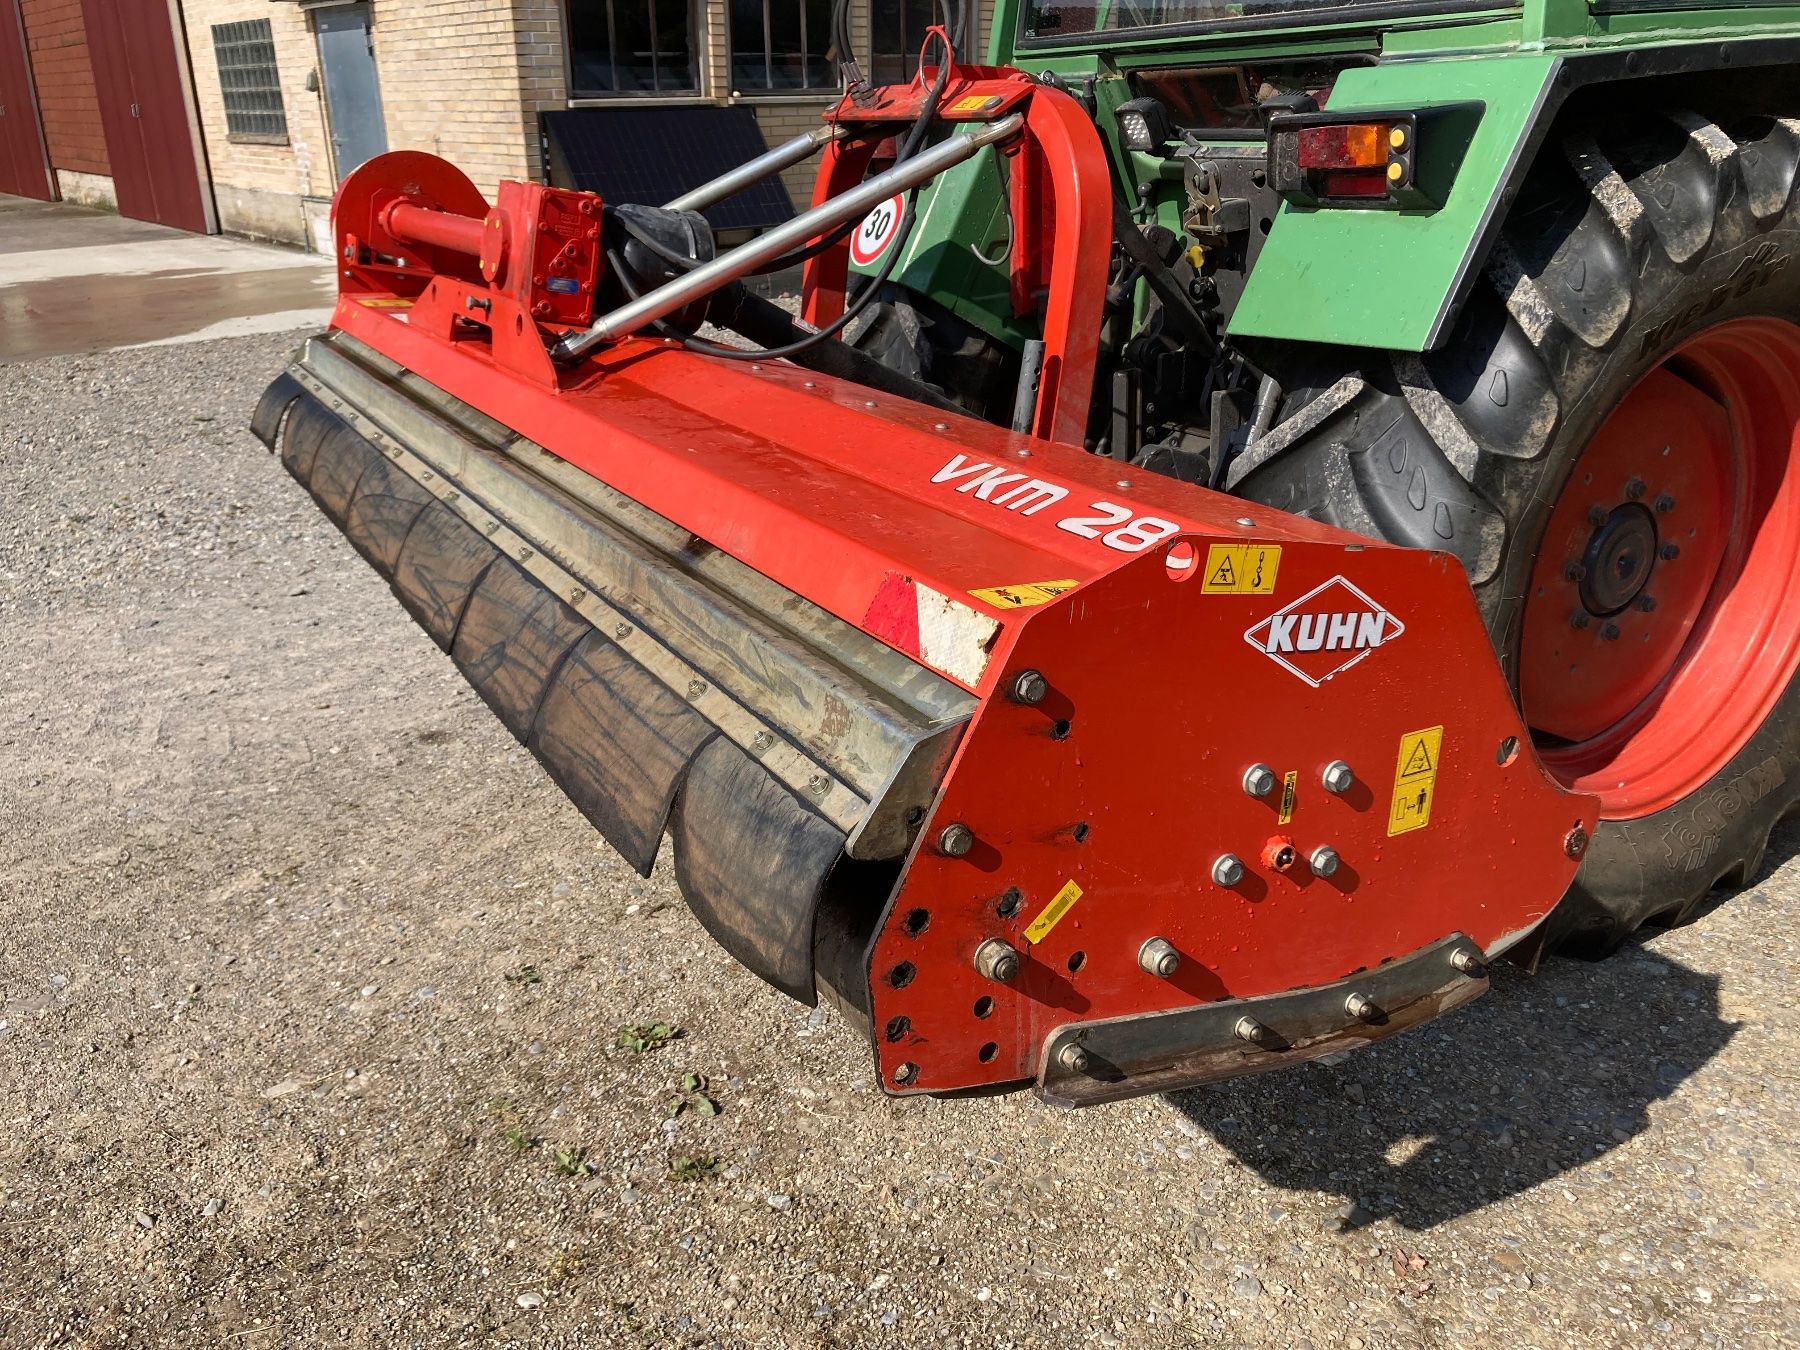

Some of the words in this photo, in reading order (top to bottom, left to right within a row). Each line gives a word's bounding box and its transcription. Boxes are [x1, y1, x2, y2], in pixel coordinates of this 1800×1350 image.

[865, 208, 891, 241] 30
[1056, 501, 1181, 553] 28
[1265, 610, 1387, 654] KUHN
